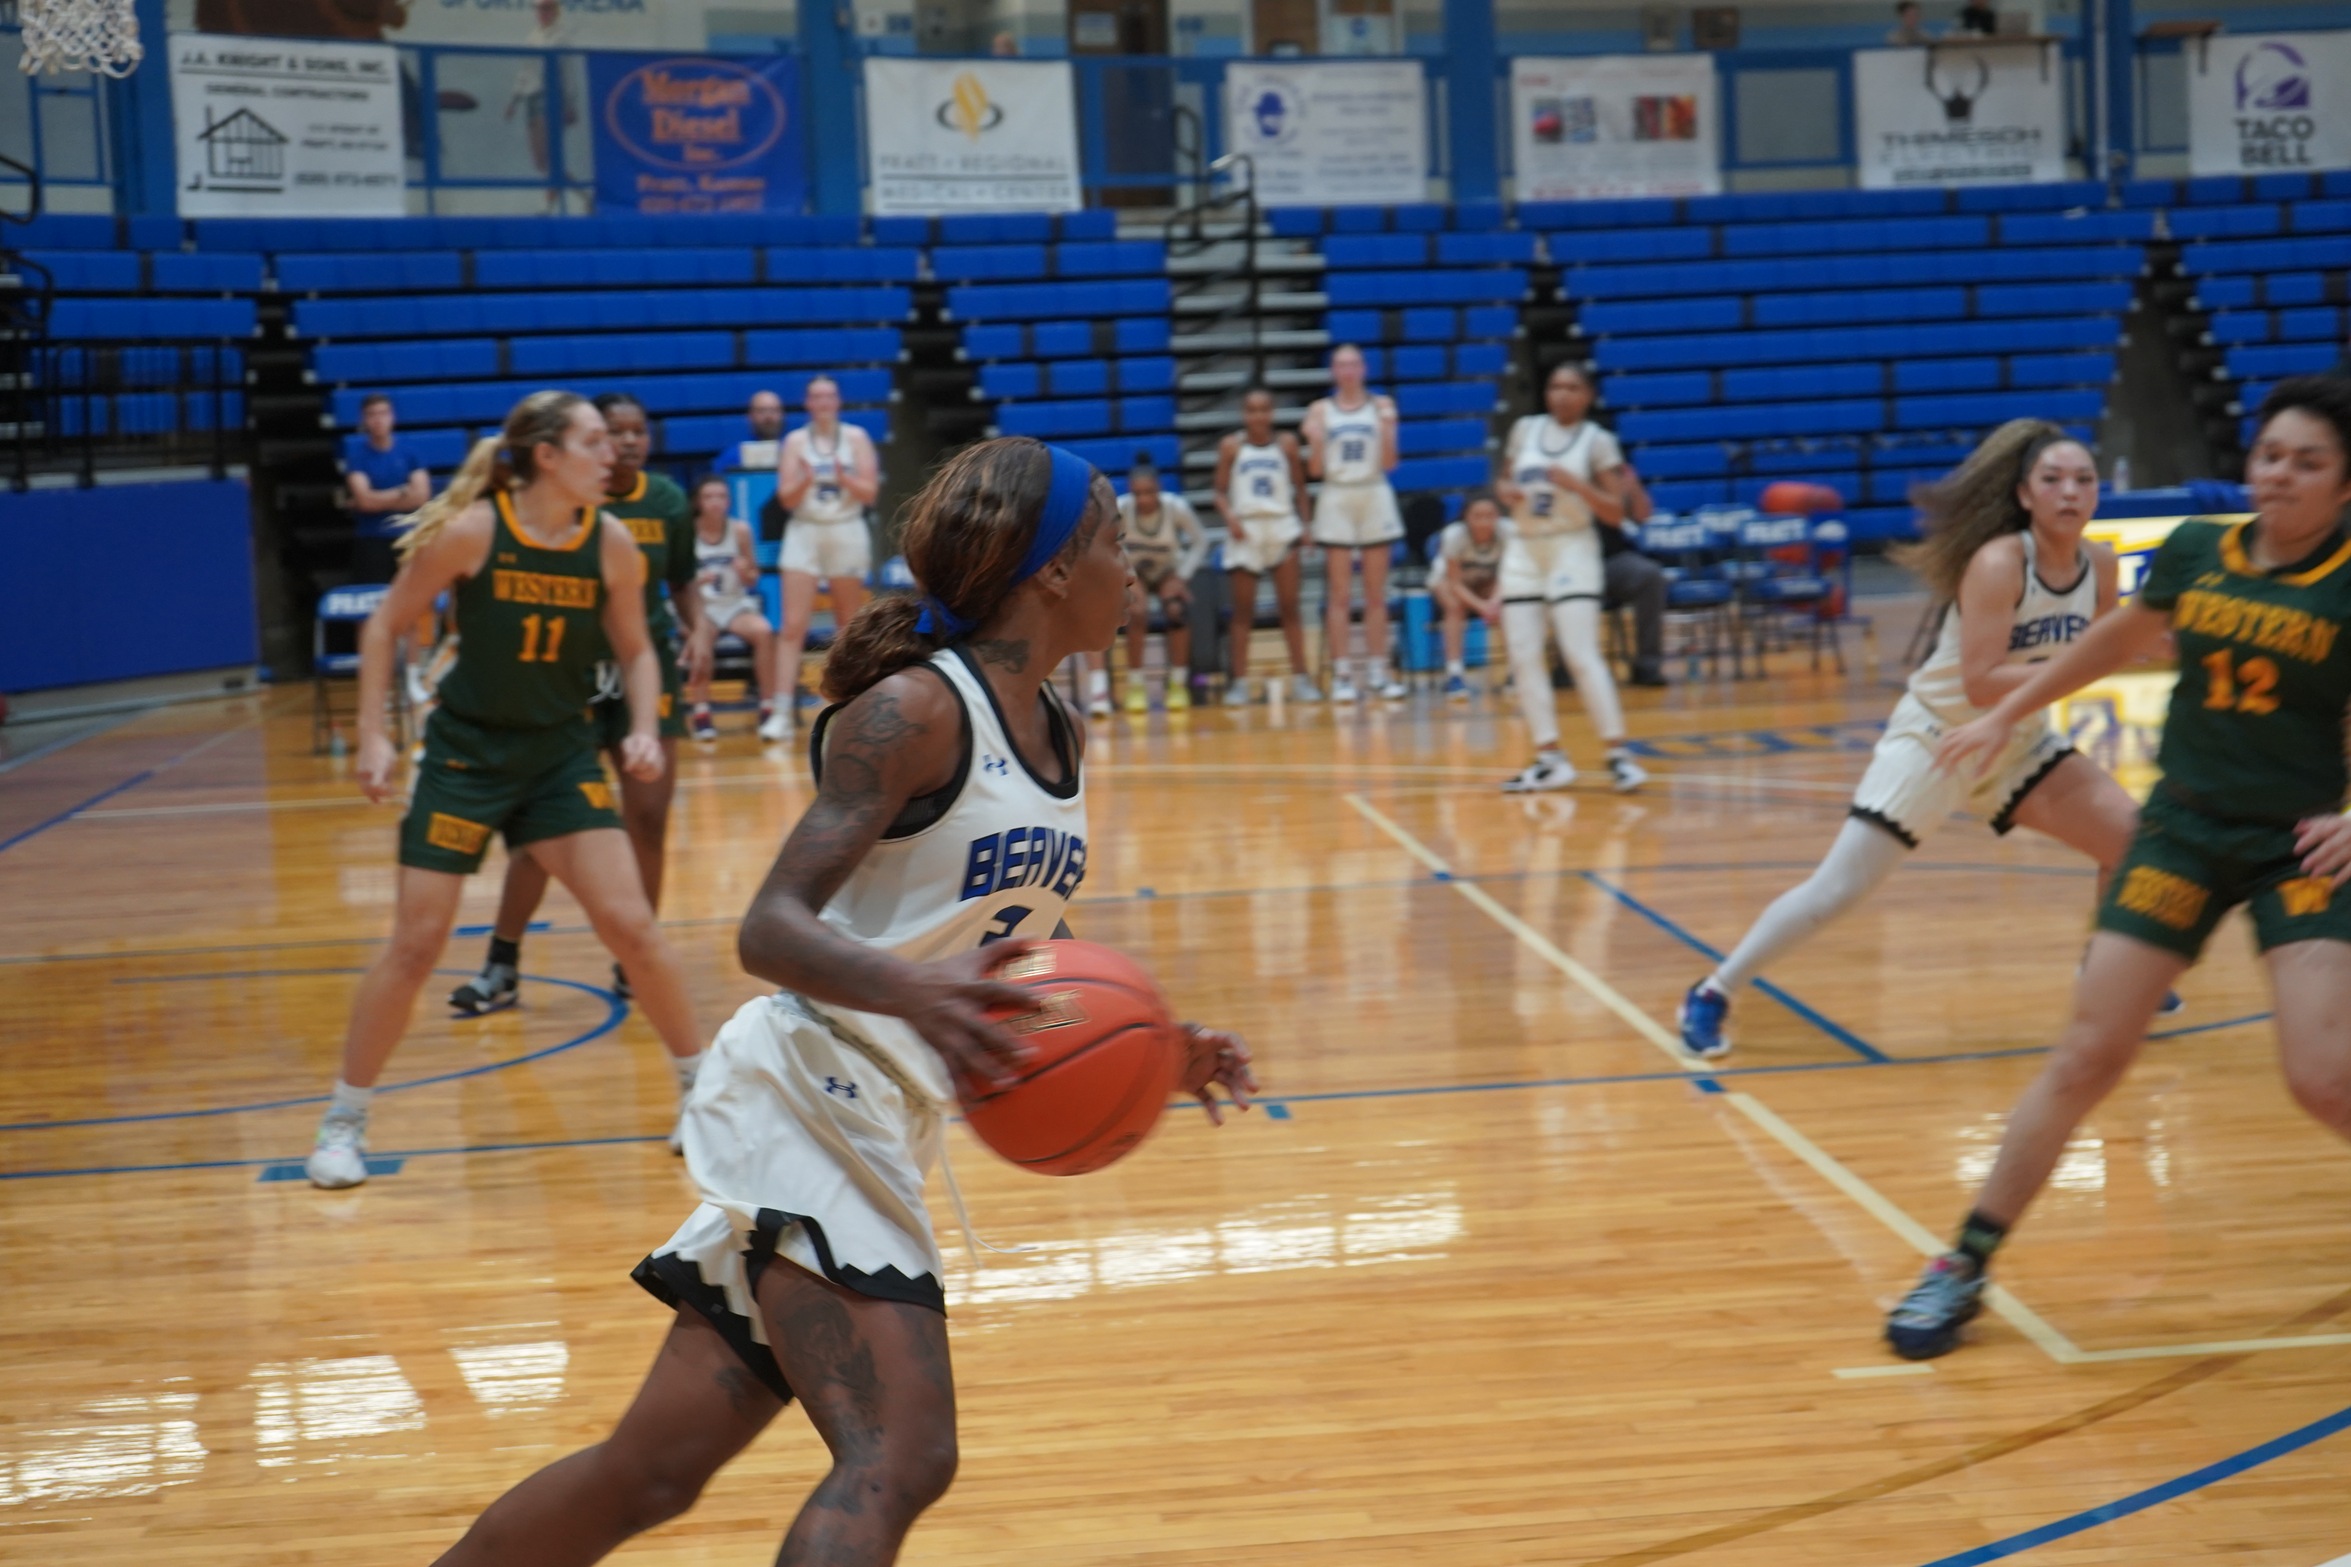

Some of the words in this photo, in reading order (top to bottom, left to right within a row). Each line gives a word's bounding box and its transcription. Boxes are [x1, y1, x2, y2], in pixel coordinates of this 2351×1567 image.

[216, 53, 281, 67] KNIGHT
[287, 57, 298, 70] &
[2235, 116, 2315, 141] TACO
[2239, 142, 2312, 167] BELL
[492, 569, 599, 609] WESTERN
[517, 612, 566, 662] 11
[2173, 590, 2342, 664] WESTERN
[2203, 648, 2280, 715] 12
